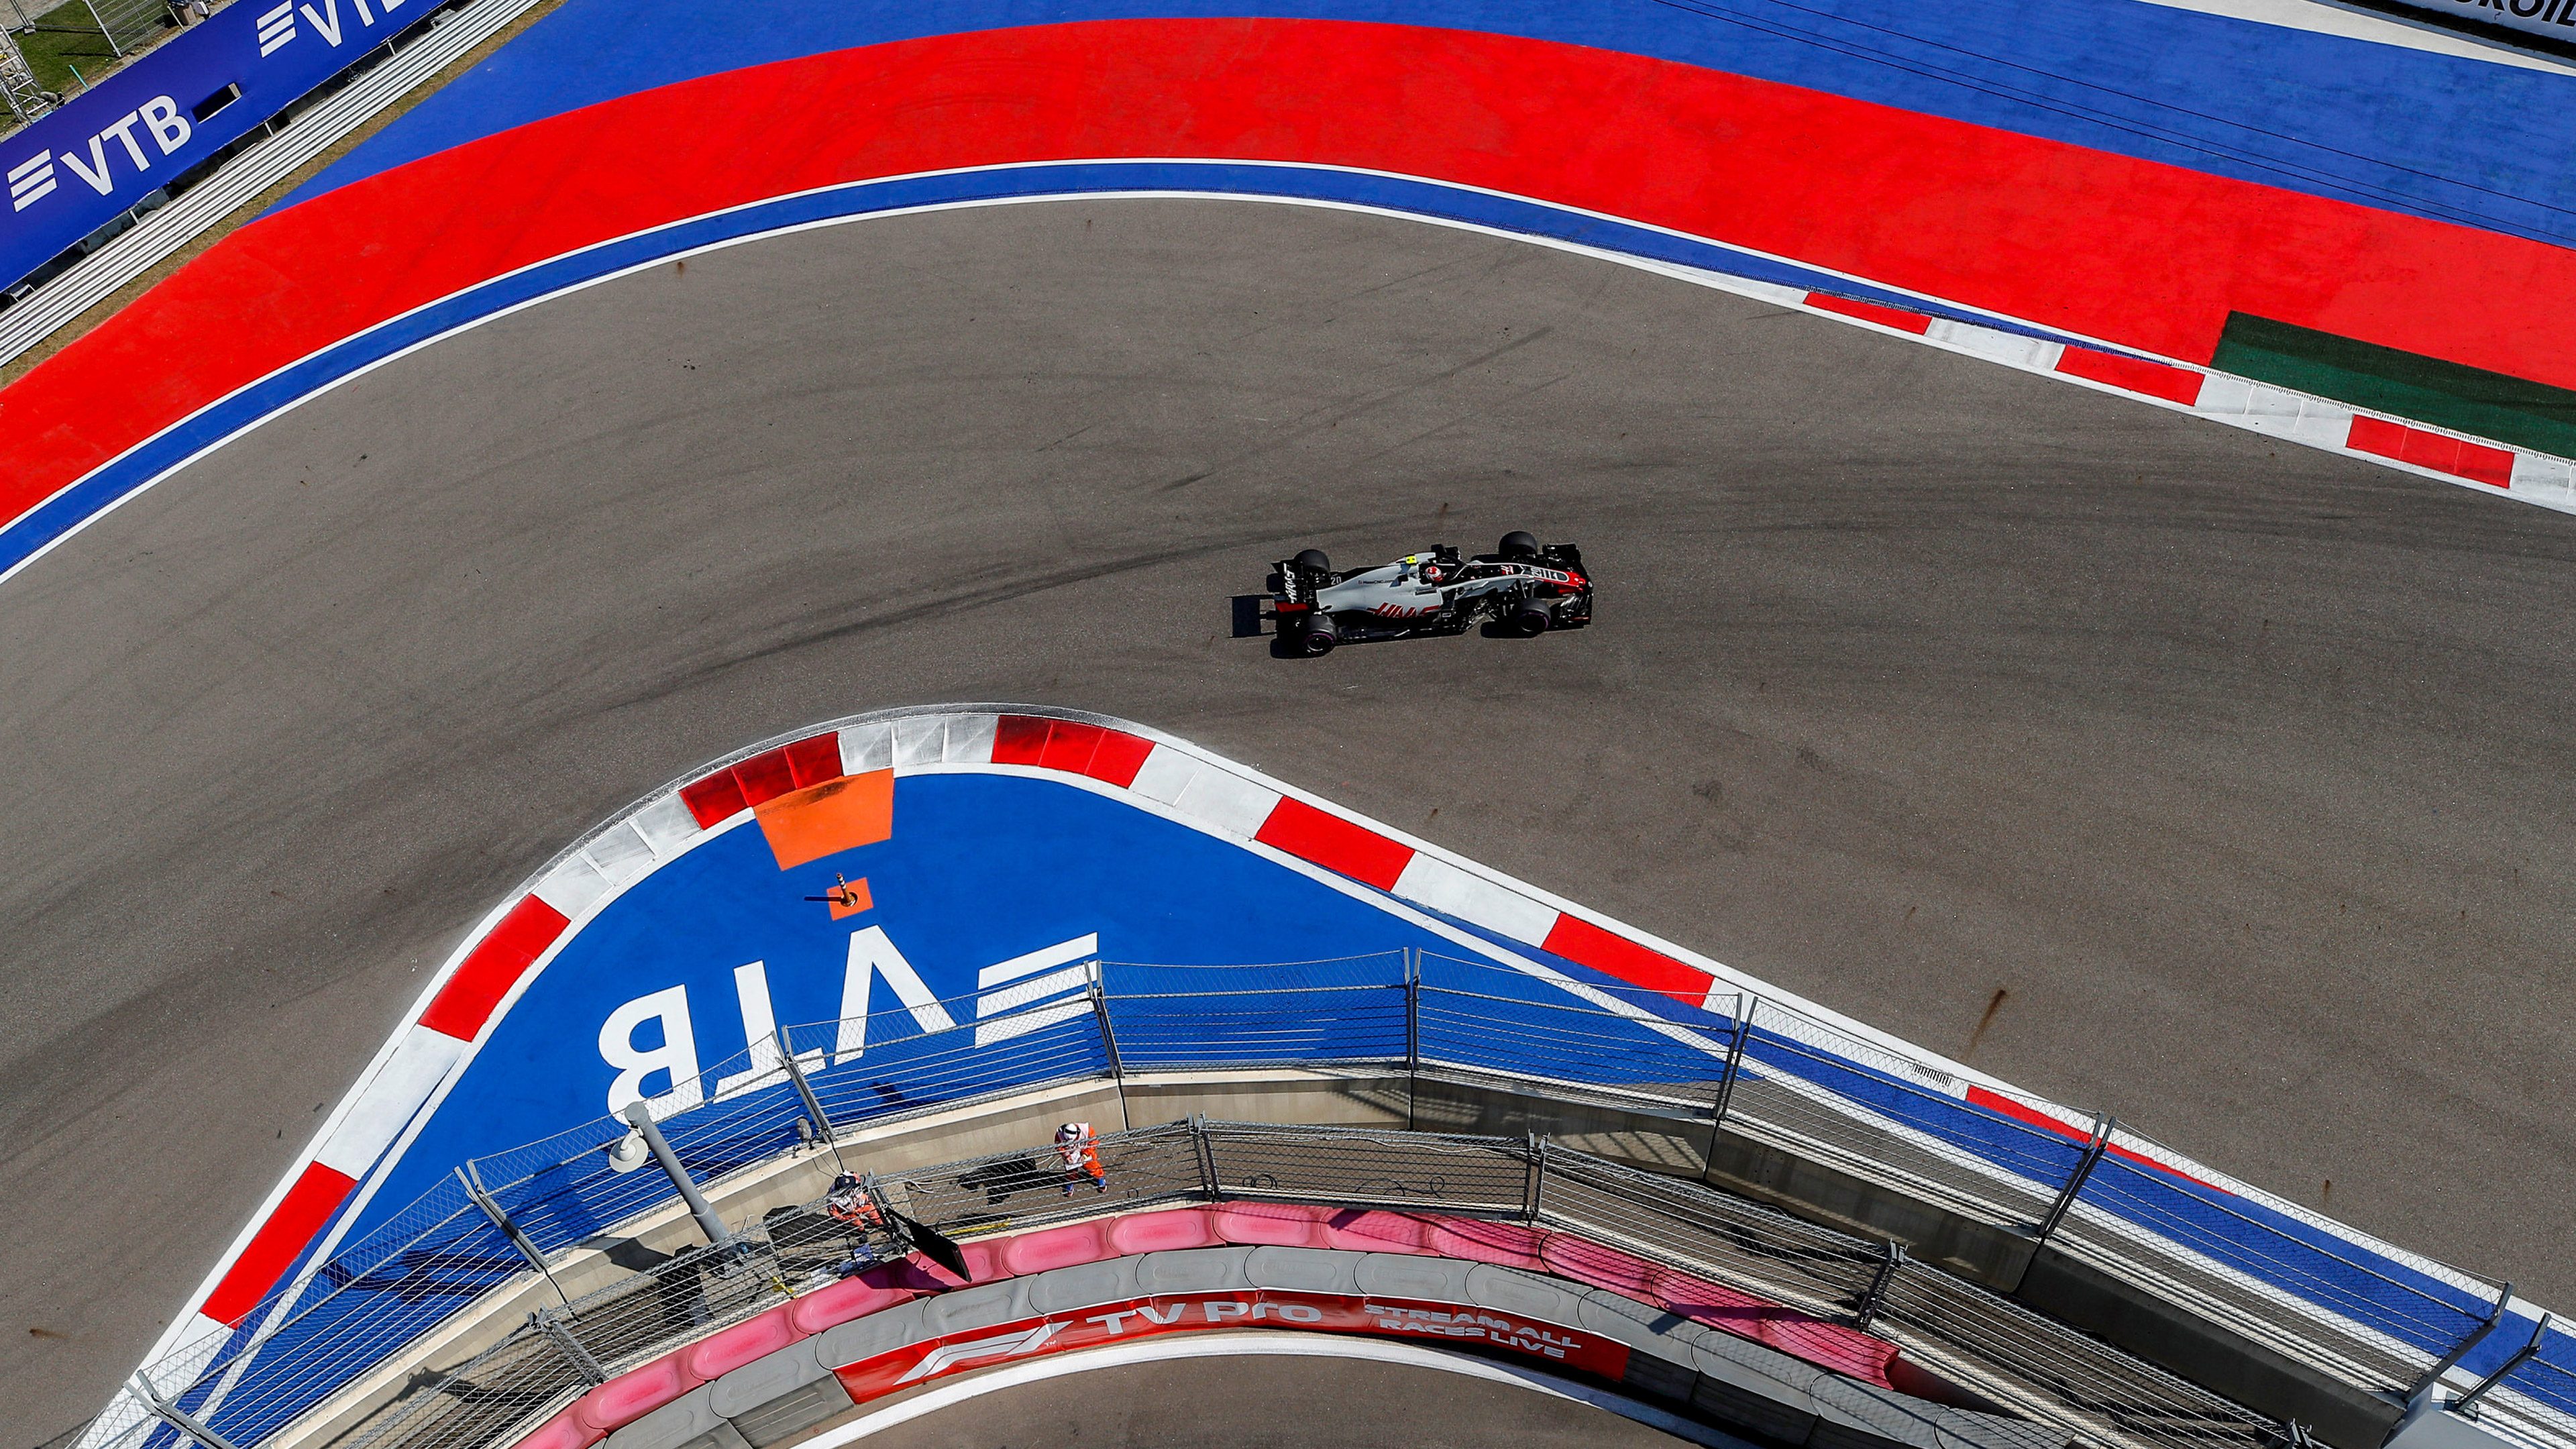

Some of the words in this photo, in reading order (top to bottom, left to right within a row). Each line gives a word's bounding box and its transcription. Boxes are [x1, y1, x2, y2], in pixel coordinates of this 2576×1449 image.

[2453, 0, 2576, 27] OIL
[60, 95, 192, 197] VTB
[1330, 576, 1342, 585] 20
[598, 925, 956, 1126] VTB
[1086, 1303, 1186, 1335] TV
[1364, 1304, 1510, 1332] STREAM
[1516, 1327, 1582, 1349] ALL
[1379, 1318, 1486, 1337] RACES
[1491, 1331, 1565, 1358] LIVE
